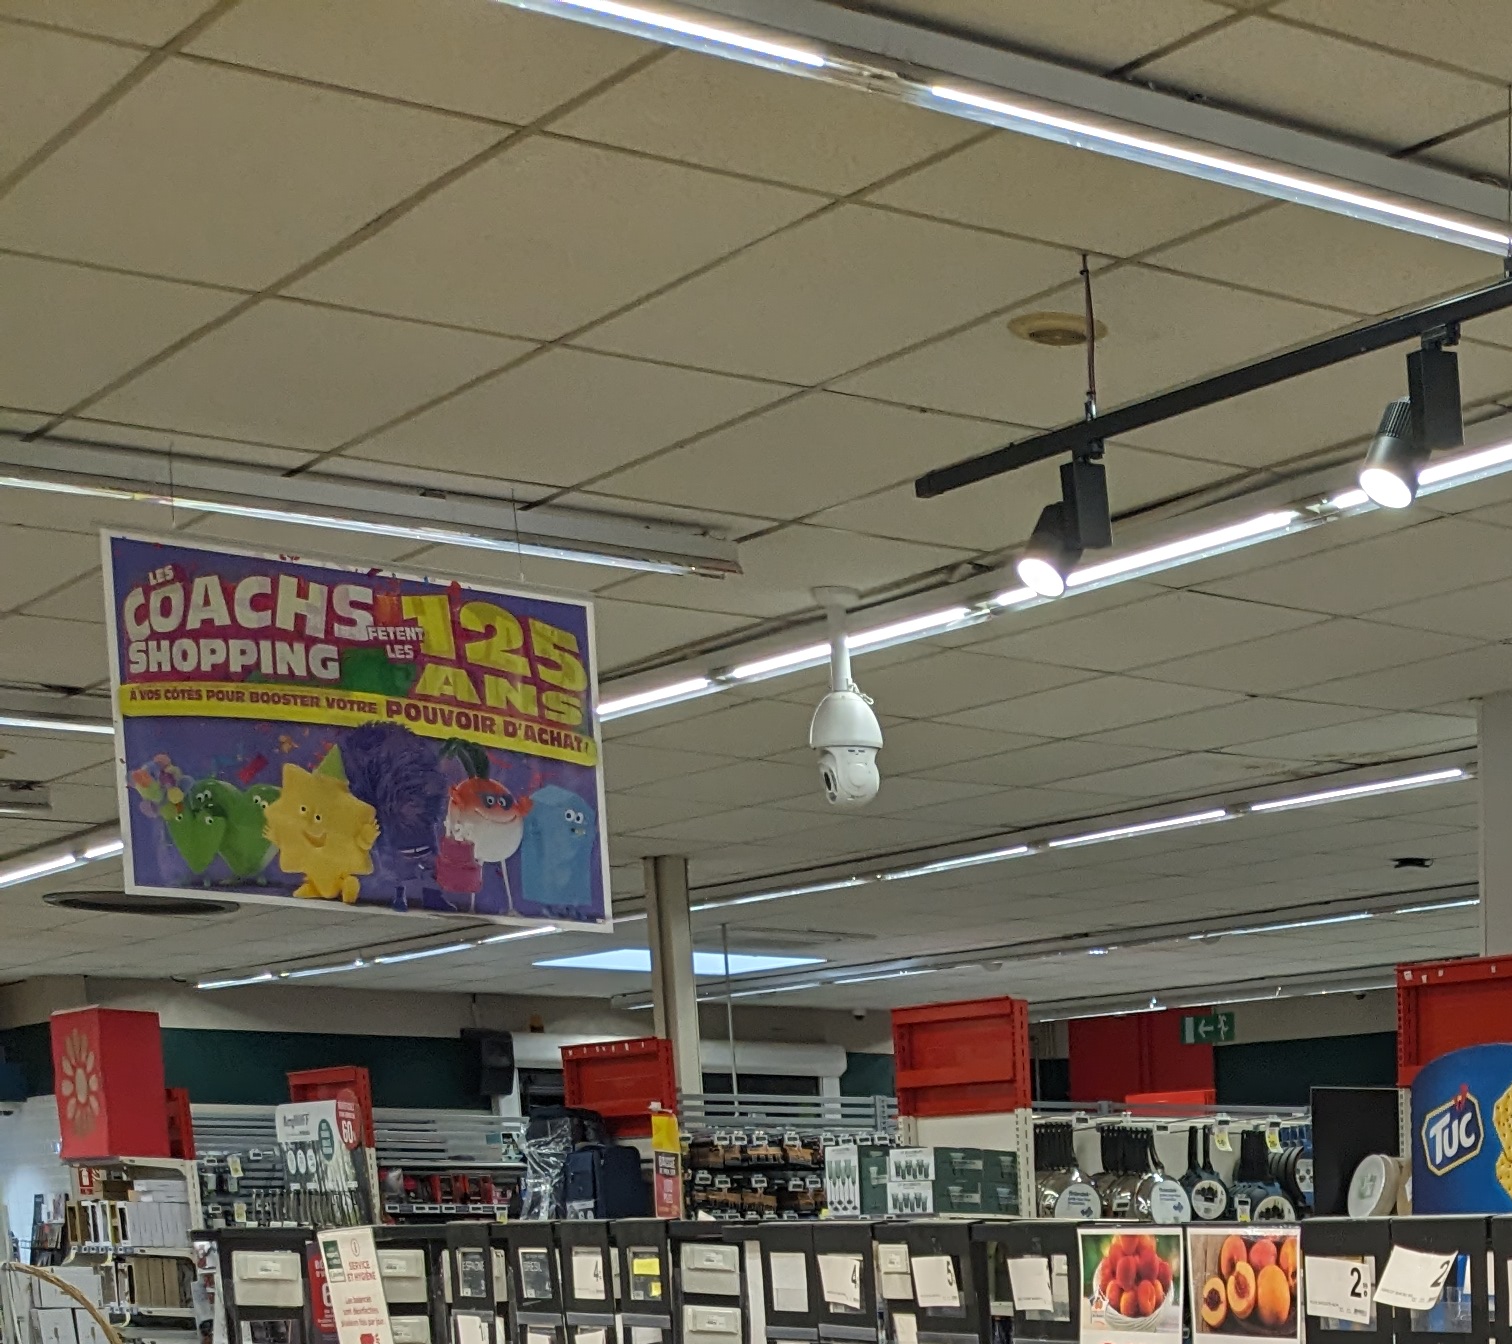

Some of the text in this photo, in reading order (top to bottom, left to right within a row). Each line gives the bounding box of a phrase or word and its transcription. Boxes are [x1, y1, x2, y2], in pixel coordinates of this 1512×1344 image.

[149, 565, 174, 585] LES
[124, 575, 376, 642] COACHS
[128, 638, 340, 679] SHOPPING
[386, 645, 414, 659] LES
[401, 594, 588, 692] 125
[139, 689, 161, 701] VOS
[164, 686, 203, 702] CÔTÉS
[206, 690, 245, 704] POUR
[250, 690, 321, 709] BOOSTER
[325, 697, 378, 714] VOTRE
[385, 700, 497, 734] POUVOIR
[415, 663, 583, 726] ANS
[1430, 1110, 1476, 1165] TUC
[1350, 1267, 1362, 1298] 2
[1429, 1260, 1451, 1288] 2
